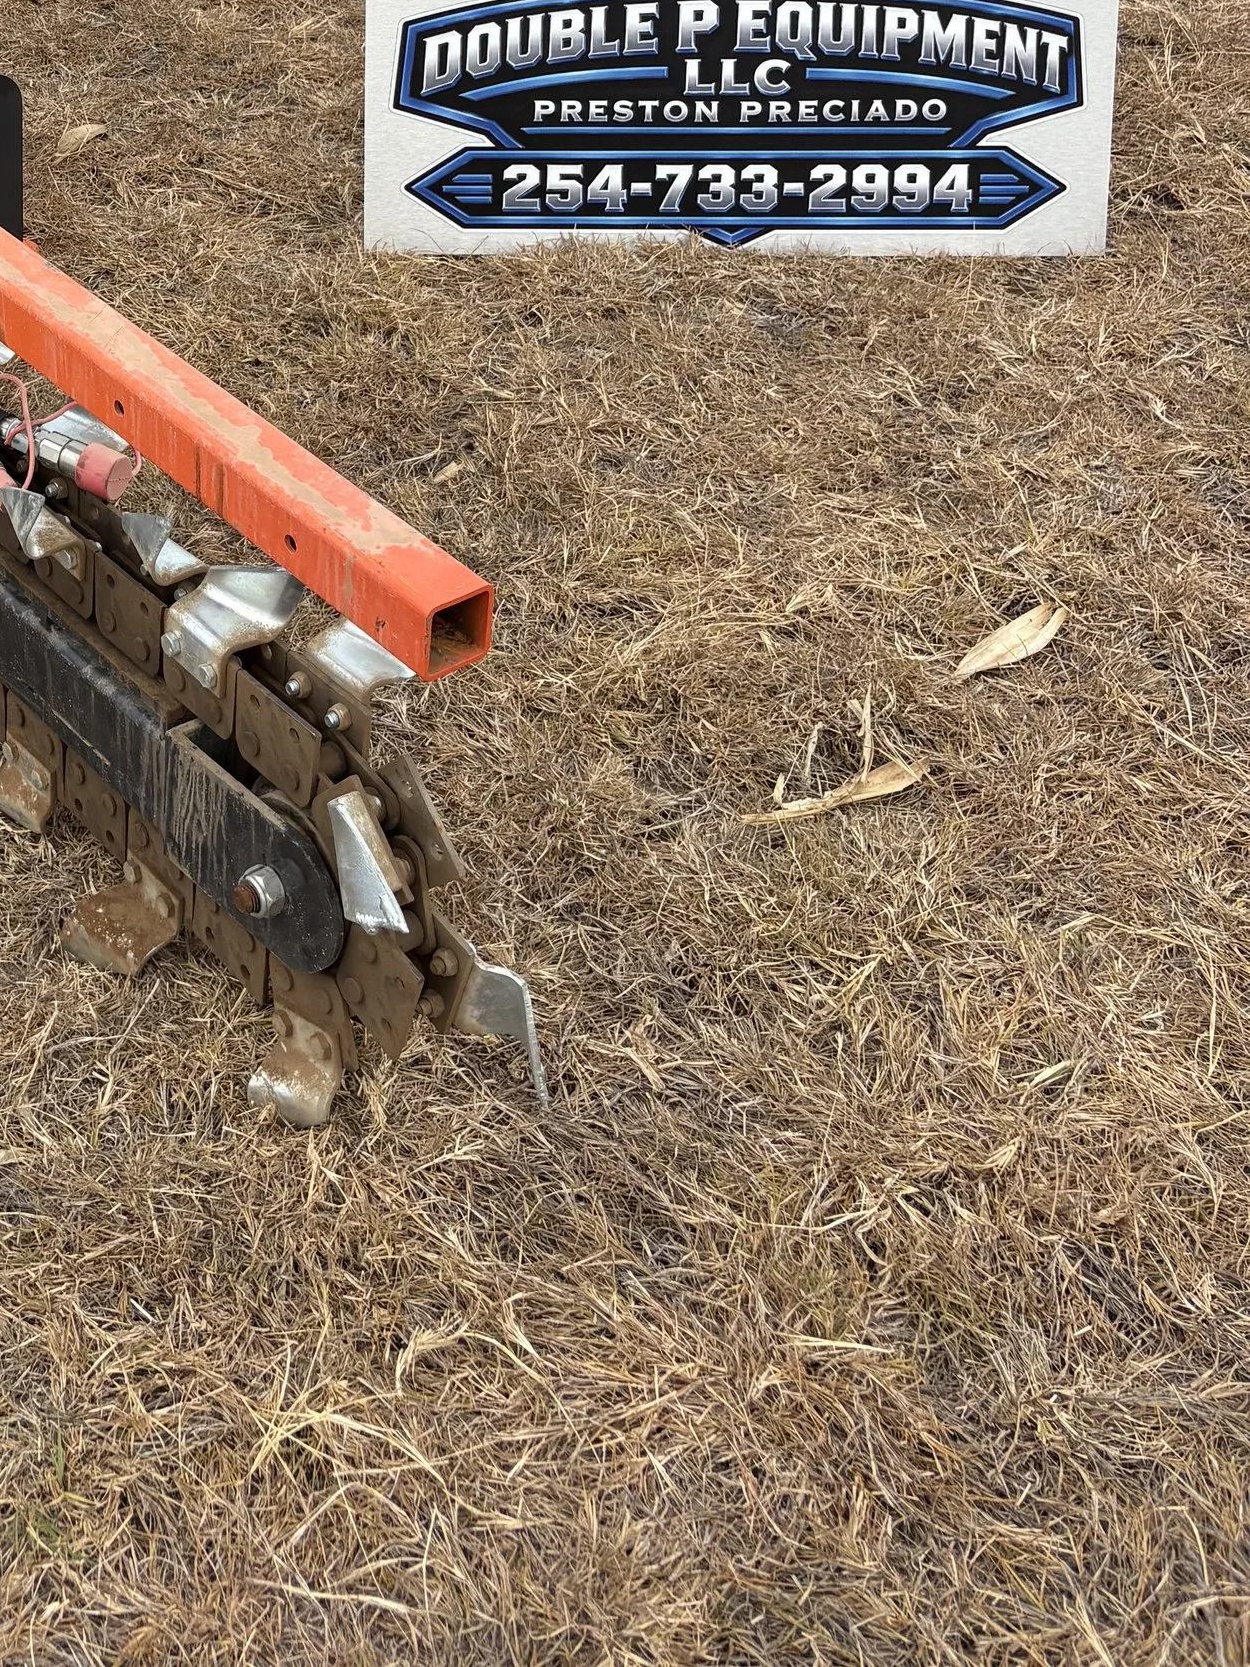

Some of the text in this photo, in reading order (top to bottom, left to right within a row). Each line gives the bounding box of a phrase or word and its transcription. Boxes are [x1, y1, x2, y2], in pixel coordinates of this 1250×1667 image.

[420, 0, 1070, 97] DOUBLE P EQUIPMENT
[683, 58, 792, 96] LLC
[533, 98, 947, 123] PRESTON PRECIADO
[501, 163, 972, 213] 254-733-2994
